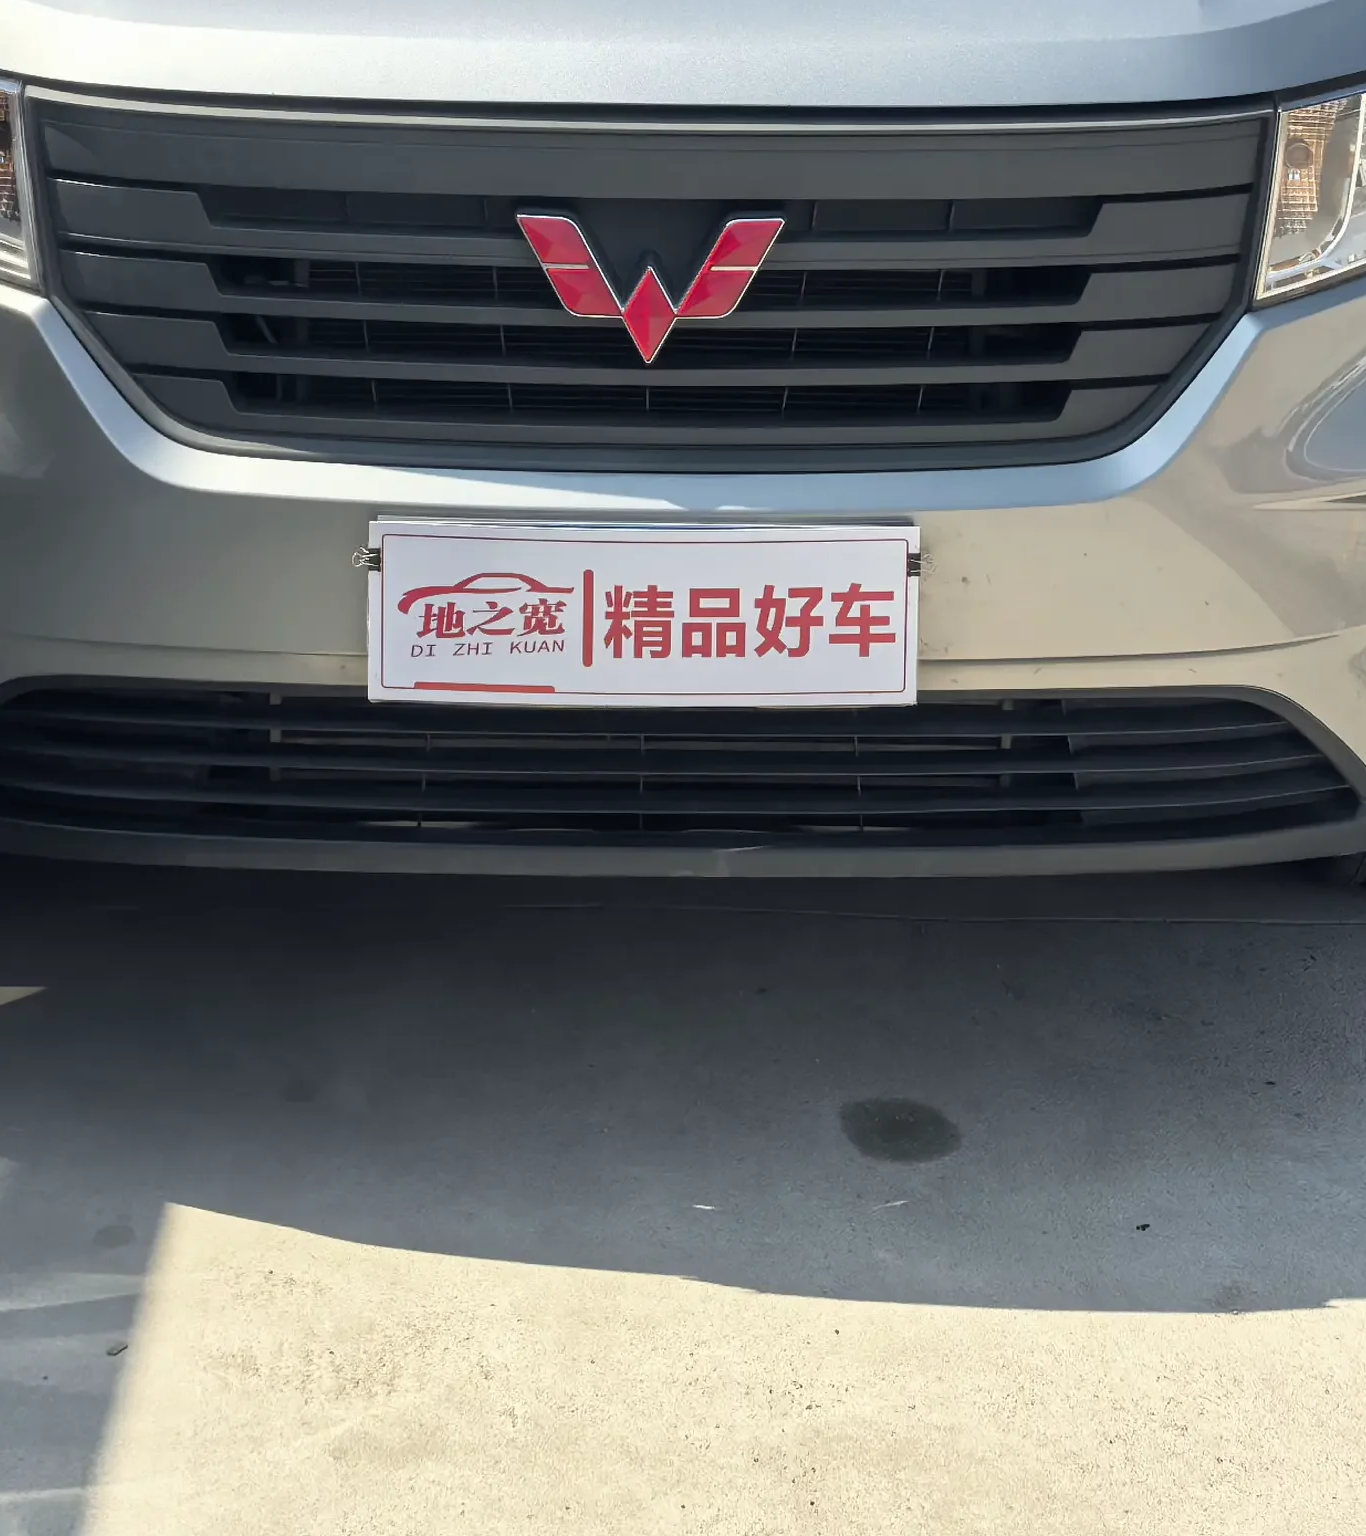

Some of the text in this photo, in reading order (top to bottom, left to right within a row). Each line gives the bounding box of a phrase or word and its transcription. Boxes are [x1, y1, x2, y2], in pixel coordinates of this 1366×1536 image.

[416, 597, 567, 639] 地之宽
[603, 582, 896, 659] 精品好车
[410, 639, 566, 658] DI ZHI KUAN
